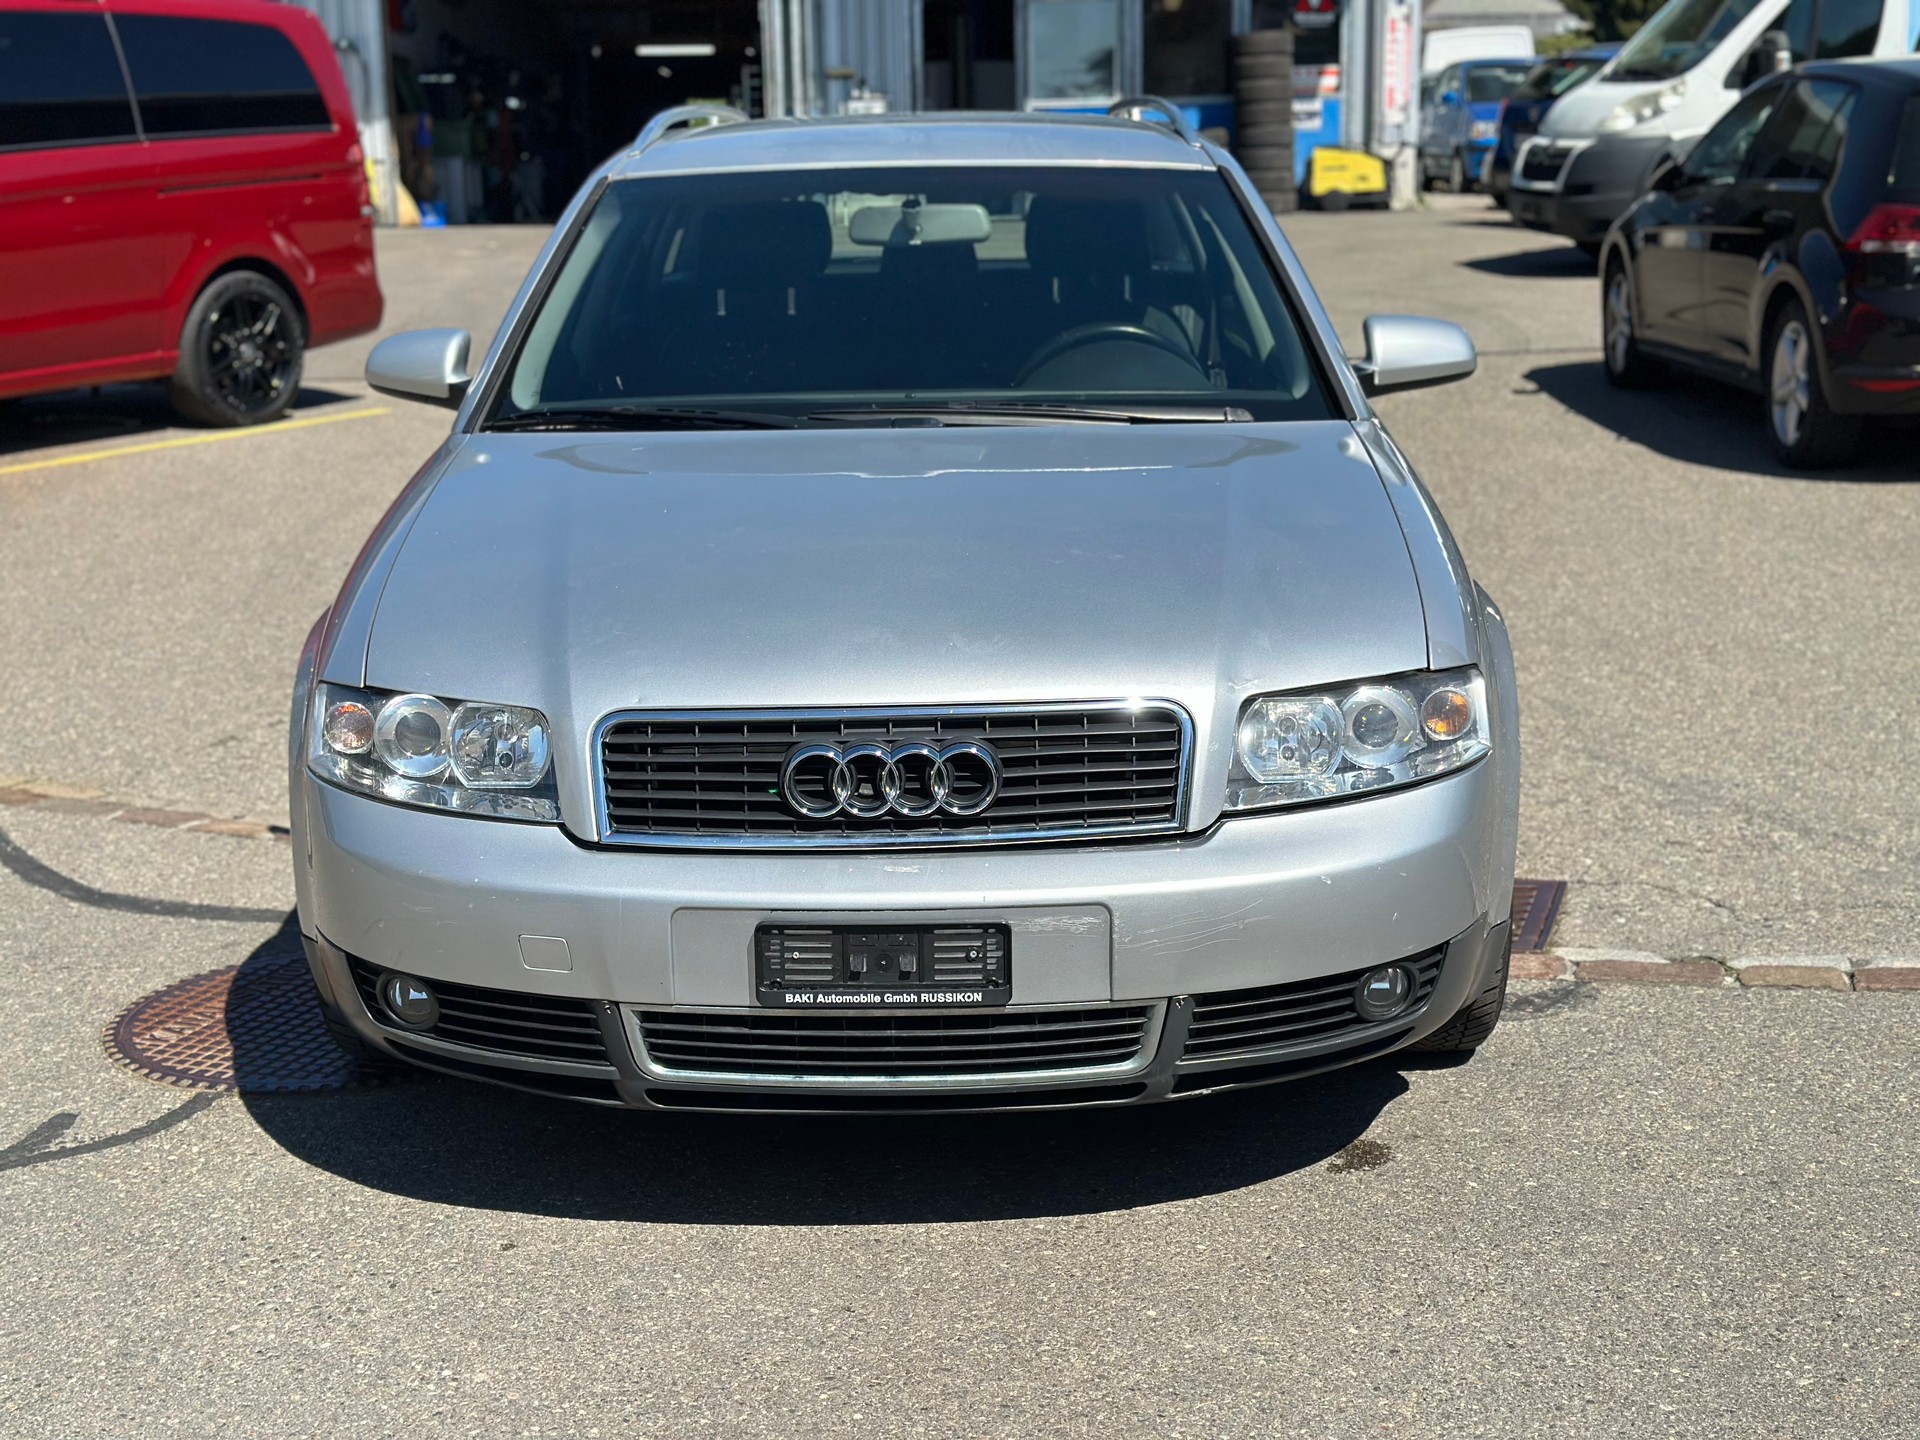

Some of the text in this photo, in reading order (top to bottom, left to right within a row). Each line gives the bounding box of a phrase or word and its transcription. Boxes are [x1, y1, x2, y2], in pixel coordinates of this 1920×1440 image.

[785, 992, 983, 1004] BAKI Automobile Gmbh RUSSIKON
